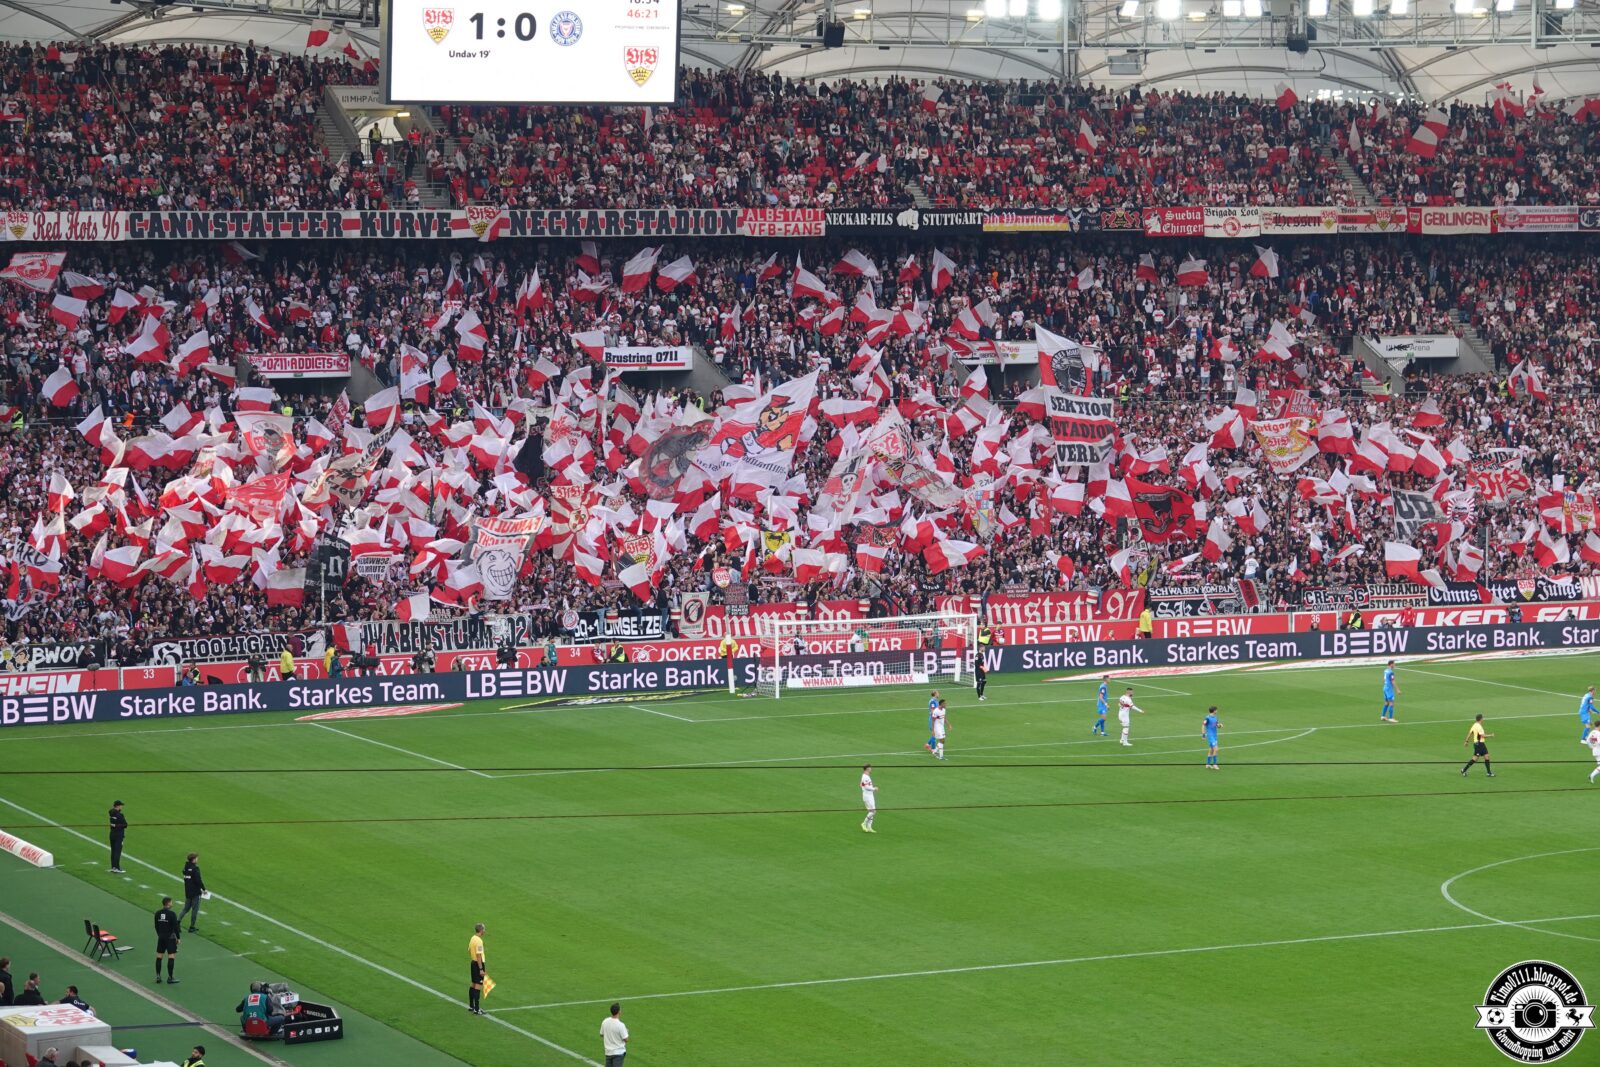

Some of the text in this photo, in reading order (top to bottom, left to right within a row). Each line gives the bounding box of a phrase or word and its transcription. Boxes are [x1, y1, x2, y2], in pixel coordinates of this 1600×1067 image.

[627, 9, 659, 18] 46:21
[449, 51, 476, 59] Undav
[746, 208, 825, 222] ALBSTADT
[827, 212, 983, 227] NECKAR-FILS STUTTGART
[1003, 212, 1056, 227] Warriors
[1166, 210, 1201, 222] Suebia
[1205, 206, 1259, 218] Brigada Loca
[1424, 210, 1489, 227] GERLINGEN
[33, 211, 62, 240] Red
[66, 211, 98, 240] Hots
[102, 211, 121, 240] 96
[130, 211, 452, 239] CANNSTATTER KURVE
[510, 210, 738, 236] NECKARSTADION
[749, 222, 822, 236] VFB-FANS
[1163, 222, 1204, 235] Ehingen
[291, 357, 333, 370] ADDICTS
[605, 351, 679, 367] Brustring 0711
[1051, 395, 1113, 418] SEKTION
[1054, 419, 1115, 440] STADION
[1057, 442, 1102, 464] VERB
[1150, 586, 1199, 597] SCHWABEN
[1201, 583, 1236, 595] KOMPAN
[1537, 577, 1582, 601] Jungs
[685, 600, 852, 640] ommando
[1105, 591, 1140, 622] 97
[1311, 614, 1321, 623] 36
[1537, 604, 1600, 622] FAL
[605, 615, 664, 636] UMSETZE
[806, 637, 902, 655] OKETAR
[1427, 629, 1545, 651] Starke Bank.
[570, 647, 581, 657] 34
[659, 643, 761, 663] JOKERAR
[1022, 644, 1149, 670] Starke Bank.
[1167, 638, 1303, 663] Starkes Team.
[143, 669, 155, 679] 33
[588, 664, 726, 691] Starke Bank.
[745, 659, 891, 685] Starkes Team.
[873, 674, 915, 685] WINAMAX
[802, 676, 844, 687] WINAMAX
[120, 688, 268, 717] Starke Bank.
[289, 681, 446, 708] Starkes Team.
